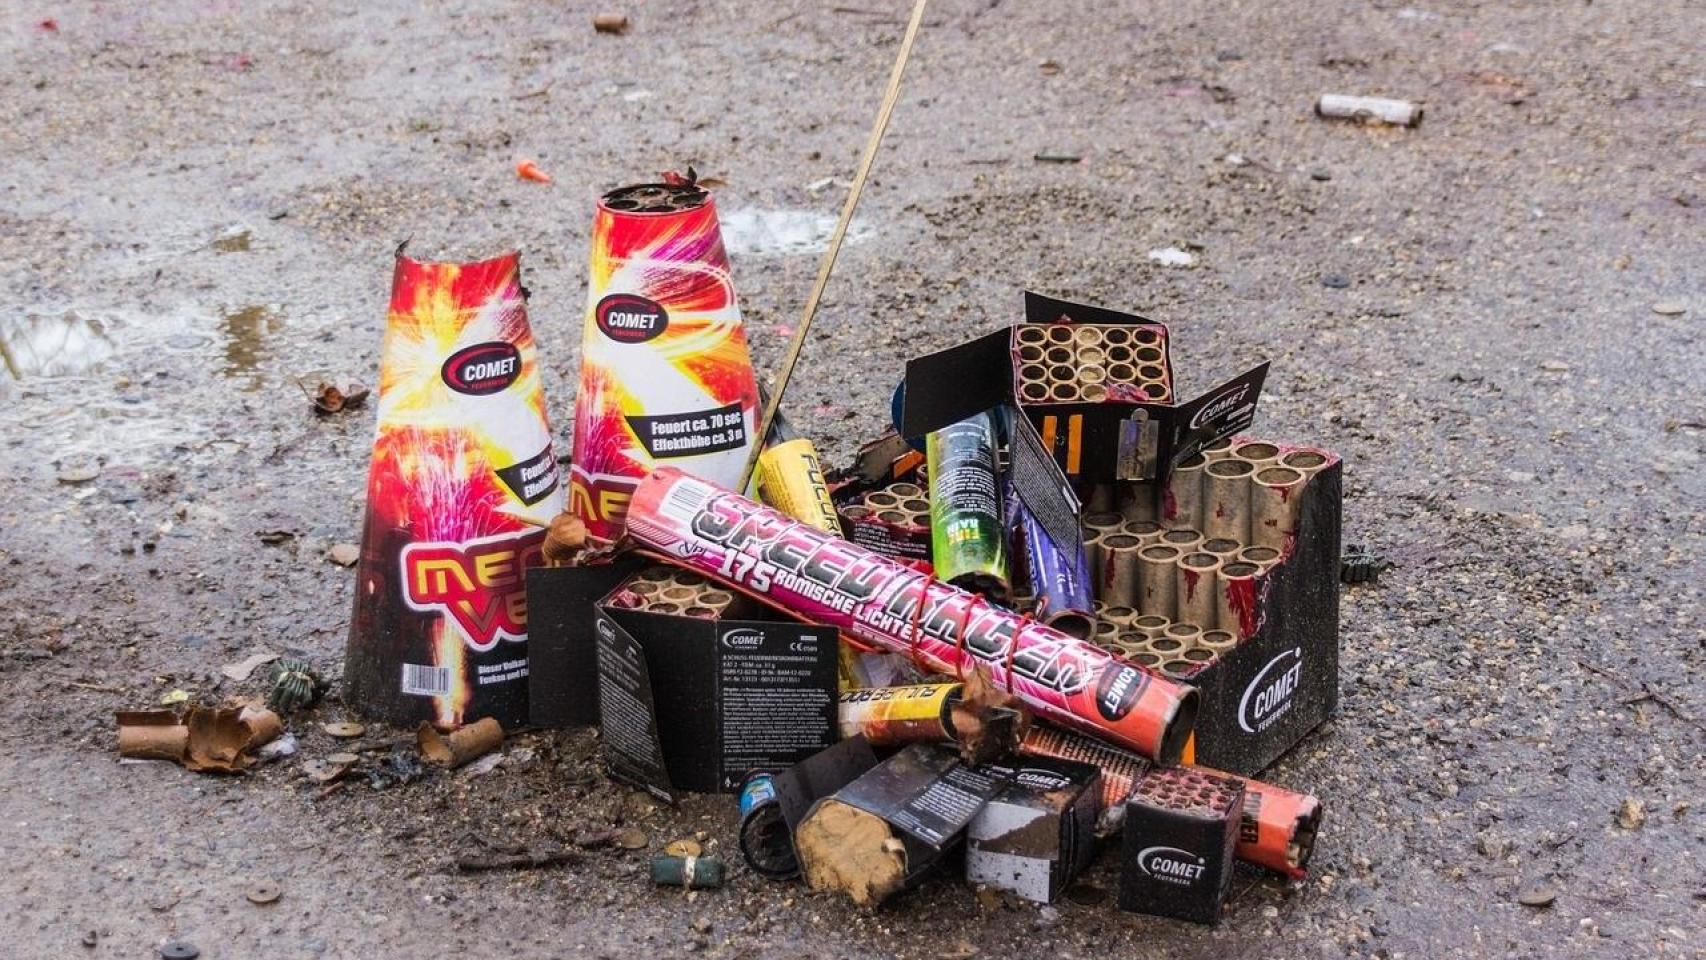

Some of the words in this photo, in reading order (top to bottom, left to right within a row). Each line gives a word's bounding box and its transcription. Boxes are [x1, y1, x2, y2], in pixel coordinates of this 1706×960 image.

[608, 311, 659, 329] COMET
[464, 356, 516, 381] COMET
[1201, 388, 1249, 421] COMET
[651, 419, 691, 436] Feuert
[692, 416, 709, 431] ca.
[711, 414, 723, 429] 70
[652, 432, 711, 452] Effekthöhe
[712, 434, 727, 448] ca.
[728, 429, 735, 442] 3
[691, 493, 893, 601] SPEED
[717, 548, 776, 593] 175
[855, 603, 924, 644] LICHTER
[732, 636, 765, 645] COMET
[1104, 668, 1137, 713] COMET
[1254, 661, 1302, 718] COMET
[1017, 772, 1069, 788] COMET
[1151, 857, 1205, 879] COMET
